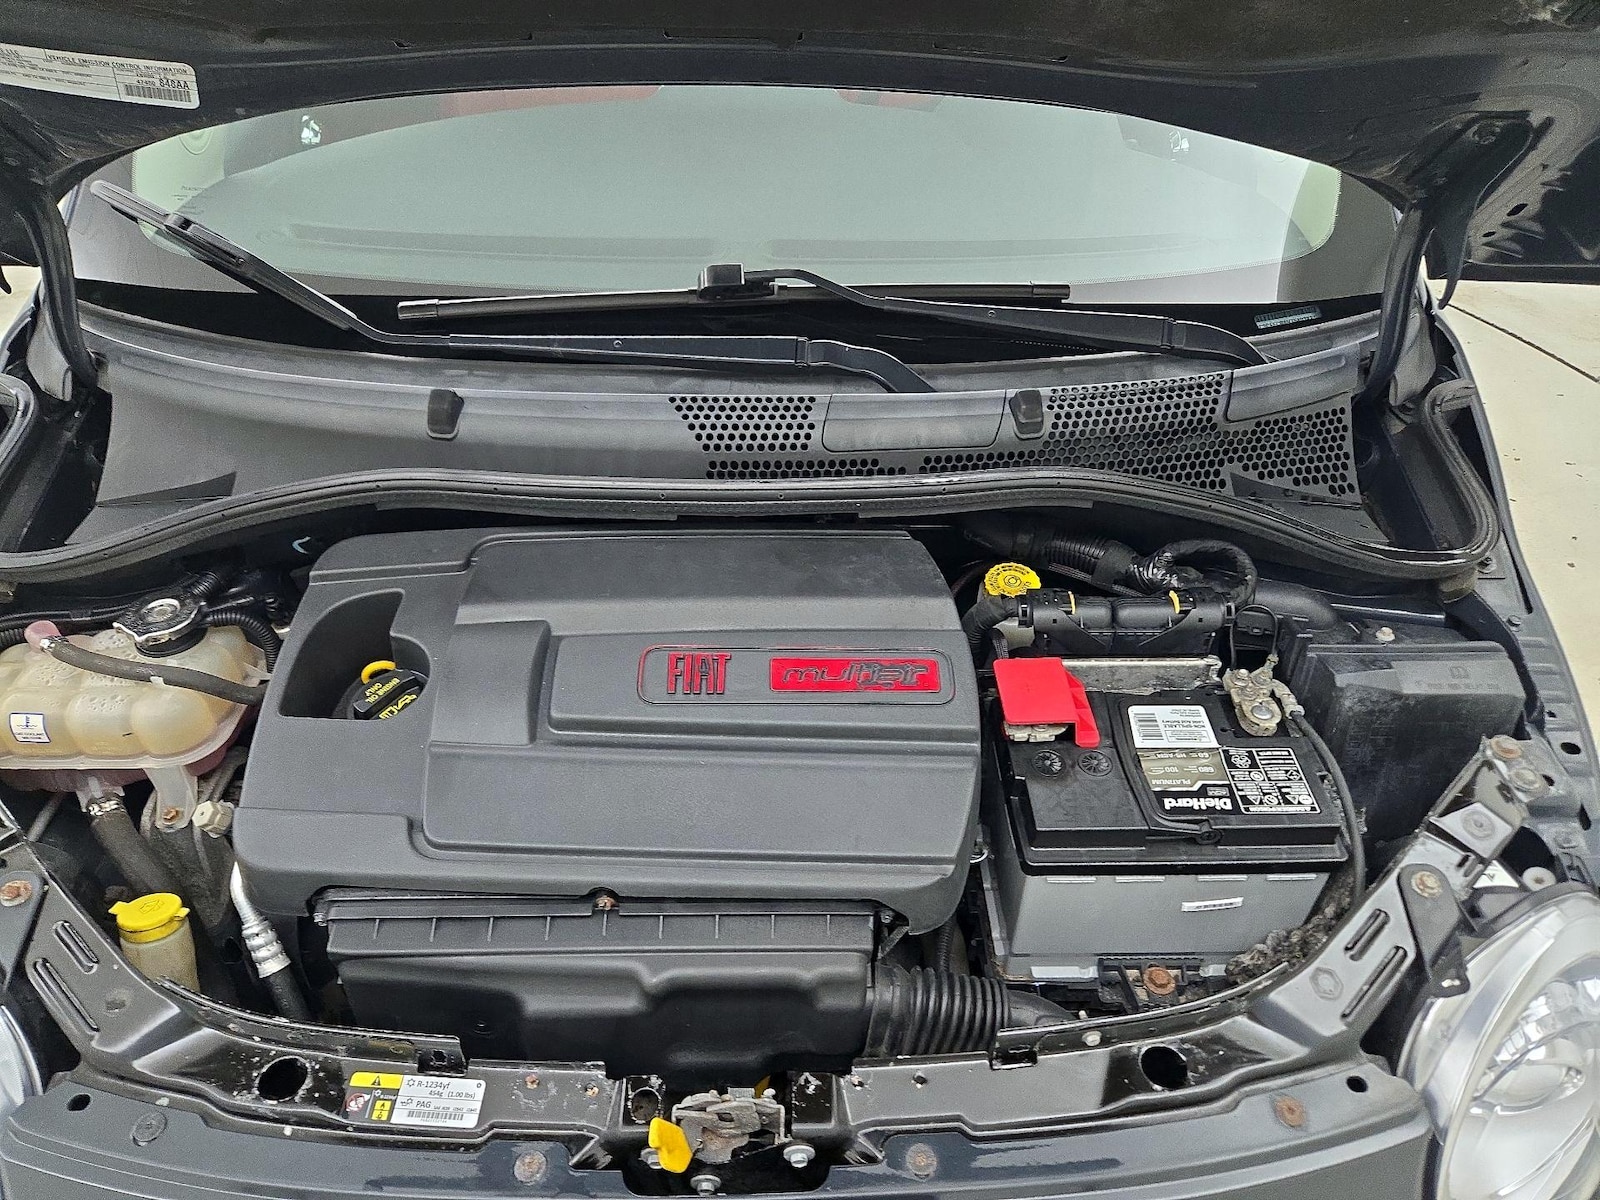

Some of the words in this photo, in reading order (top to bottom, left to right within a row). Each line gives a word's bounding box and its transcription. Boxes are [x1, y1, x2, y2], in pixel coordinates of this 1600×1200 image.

[111, 61, 141, 71] CONTROL
[144, 64, 188, 74] INFORMATION
[667, 652, 731, 694] FIAT
[365, 683, 382, 697] ONLY
[365, 694, 379, 704] OIL
[1164, 766, 1179, 774] 100
[1151, 778, 1191, 786] PLATINUM
[1163, 797, 1233, 811] DieHard
[416, 1080, 451, 1091] R-1234yf
[447, 1090, 463, 1099] (1.00
[463, 1091, 476, 1100] lbs)
[415, 1100, 431, 1109] PAG
